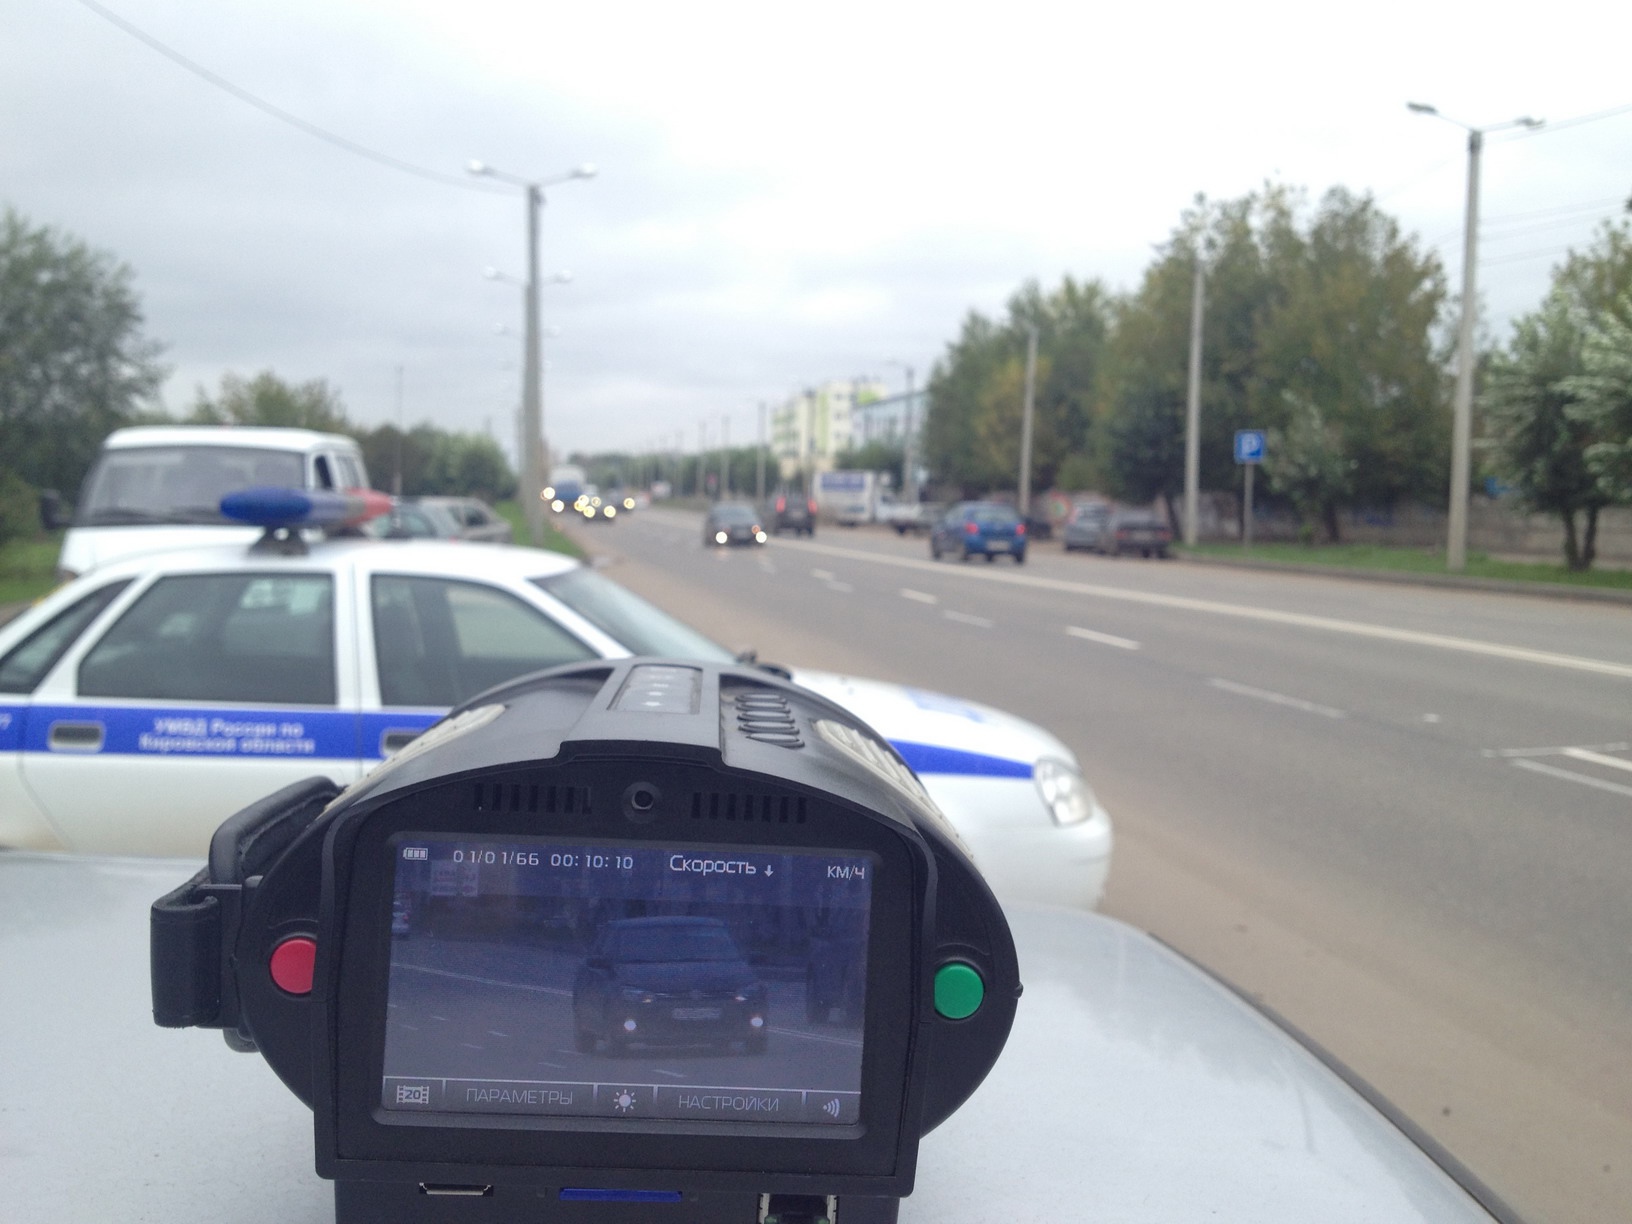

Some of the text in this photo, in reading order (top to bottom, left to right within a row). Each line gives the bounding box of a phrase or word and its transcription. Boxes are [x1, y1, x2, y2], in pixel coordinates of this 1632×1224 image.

[669, 855, 757, 876] Скорость
[404, 1089, 421, 1100] 20
[466, 1088, 573, 1105] ПАРАМЕТРЫ
[678, 1095, 779, 1112] НАСТРОЙКИ
